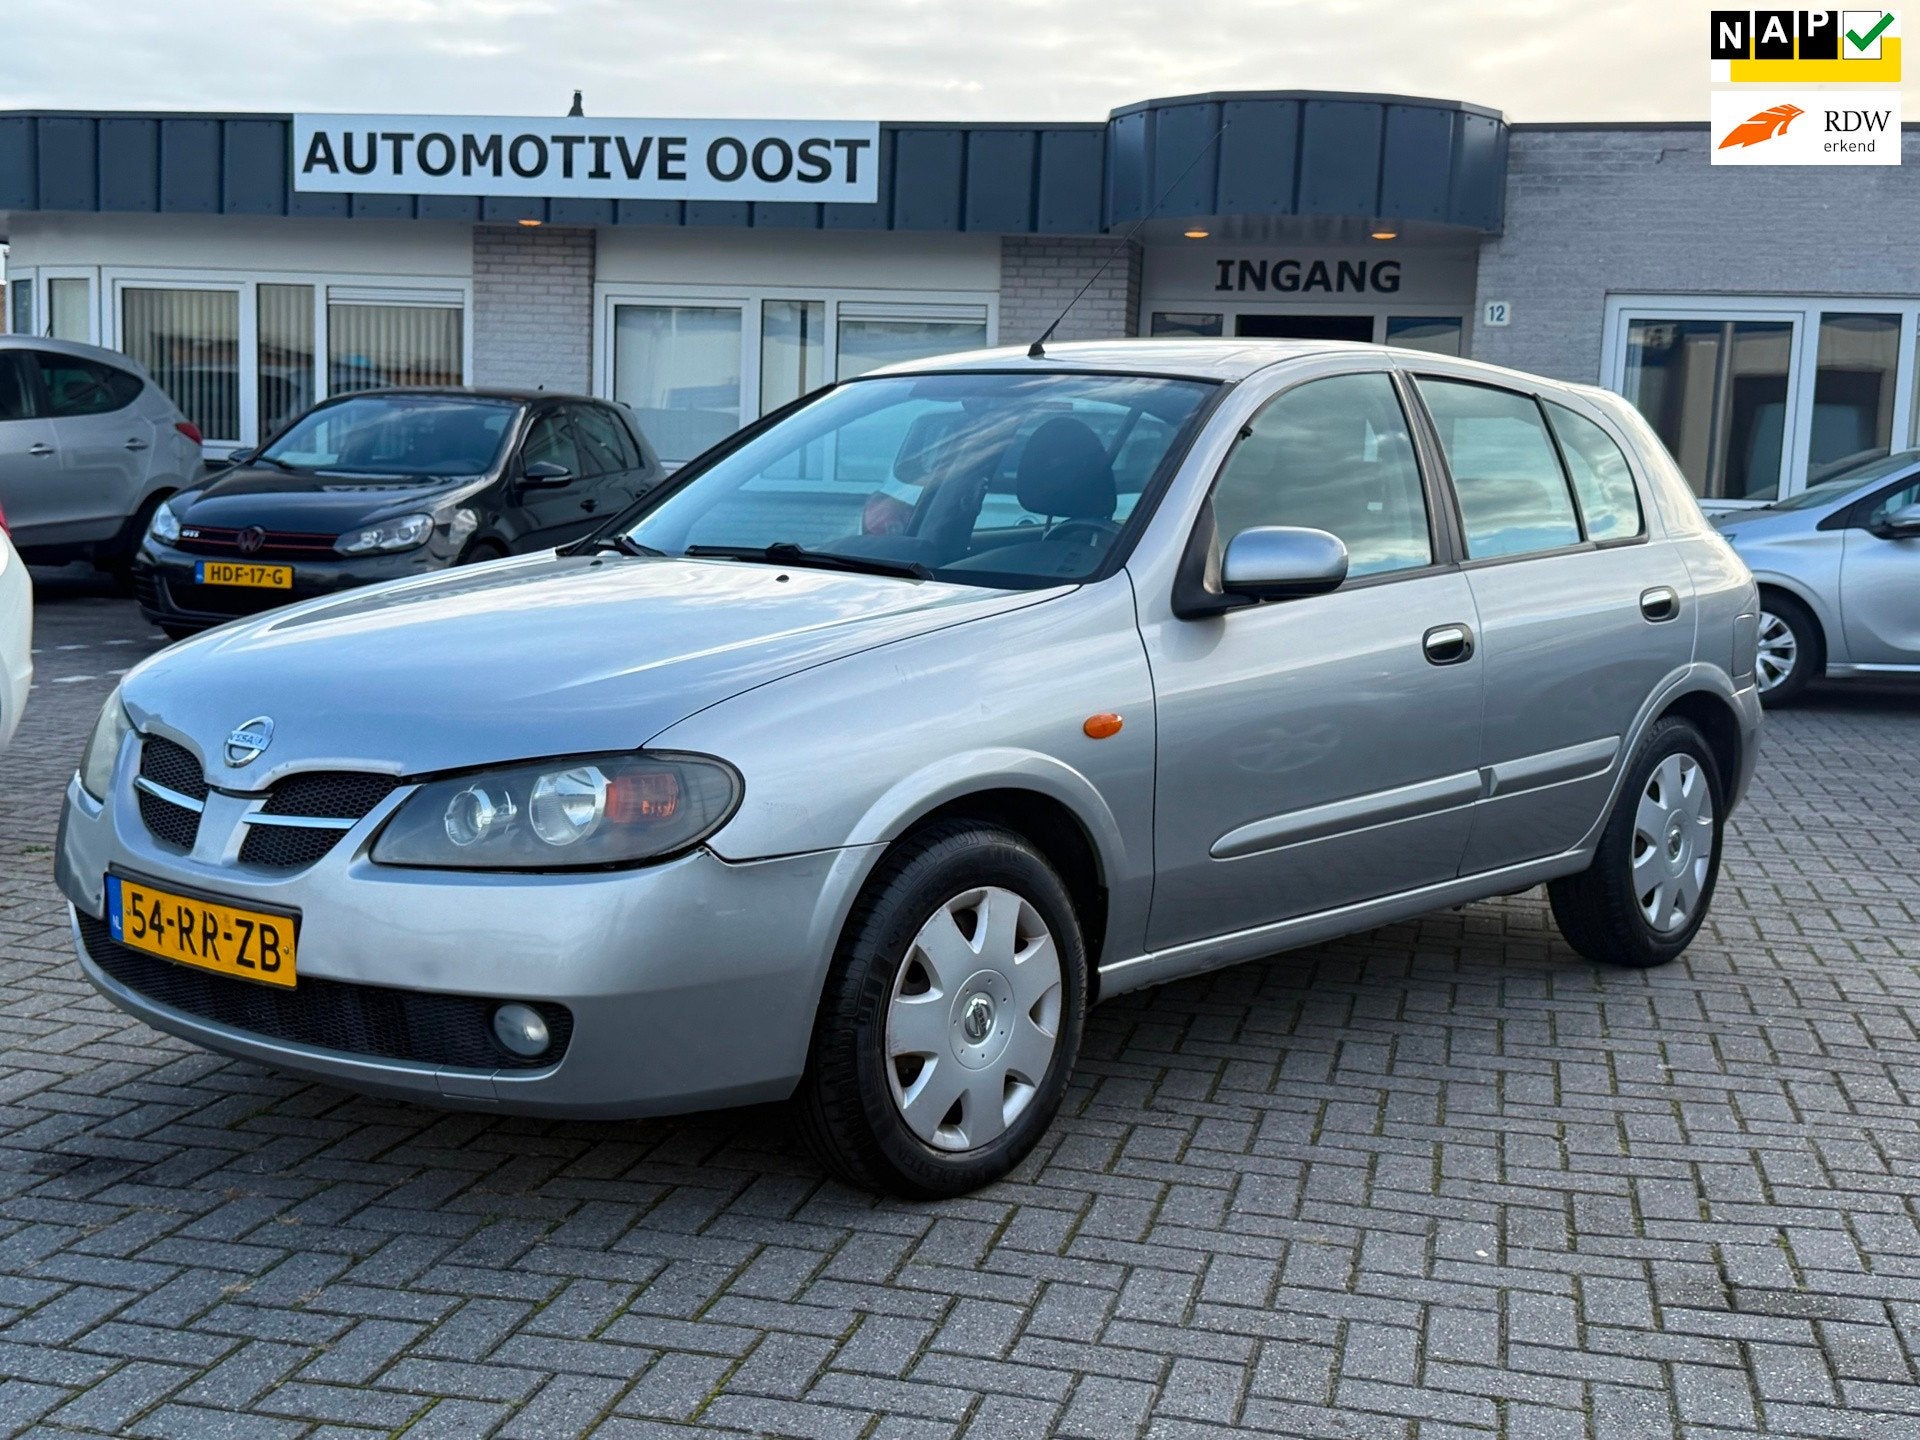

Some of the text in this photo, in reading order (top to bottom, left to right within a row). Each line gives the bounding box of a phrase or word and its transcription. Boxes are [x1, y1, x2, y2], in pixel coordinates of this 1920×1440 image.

[303, 132, 870, 184] AUTOMOTIVE OOST
[1215, 259, 1400, 293] INGANG
[1488, 305, 1505, 322] 12
[210, 566, 283, 585] HDF-17-G
[131, 891, 281, 973] 54-RR-ZB
